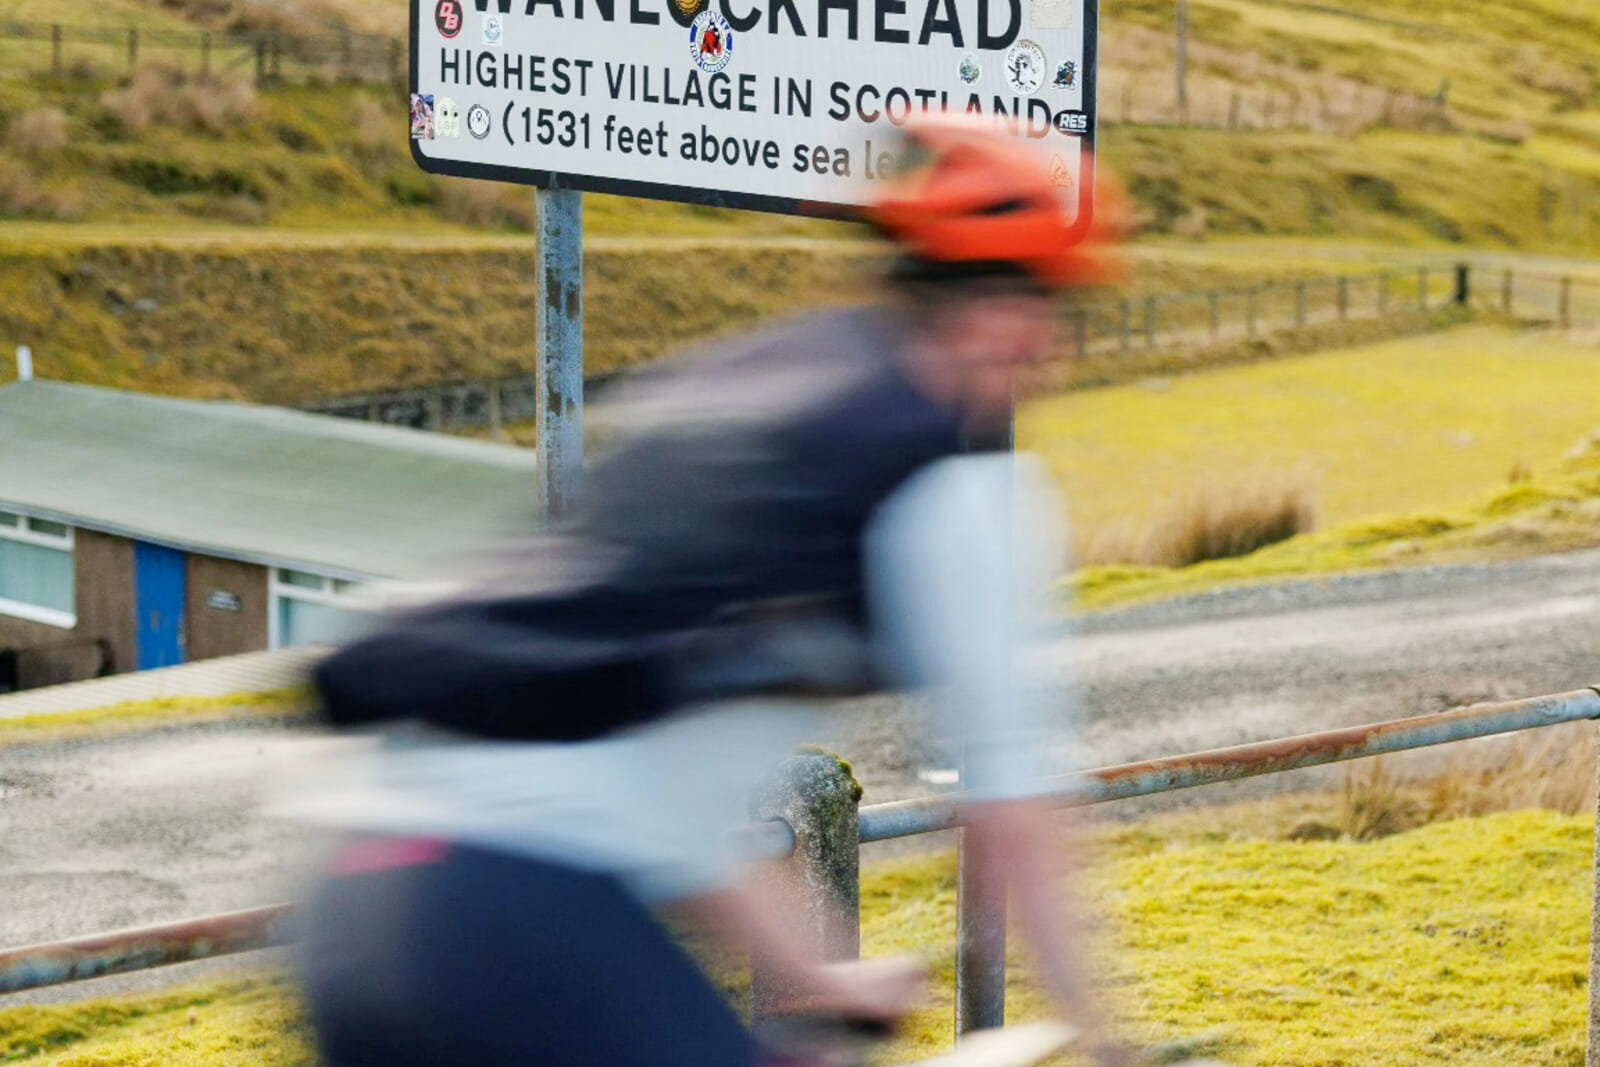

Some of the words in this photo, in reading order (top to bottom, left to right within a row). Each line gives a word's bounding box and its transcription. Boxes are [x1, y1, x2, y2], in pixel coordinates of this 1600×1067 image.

[441, 47, 593, 97] HIGHEST
[605, 62, 757, 112] VILLAGE
[773, 75, 812, 118] IN
[502, 100, 591, 149] (1531
[604, 114, 668, 157] feet
[680, 124, 780, 169] above
[792, 143, 850, 177] sea
[1060, 113, 1087, 129] RES
